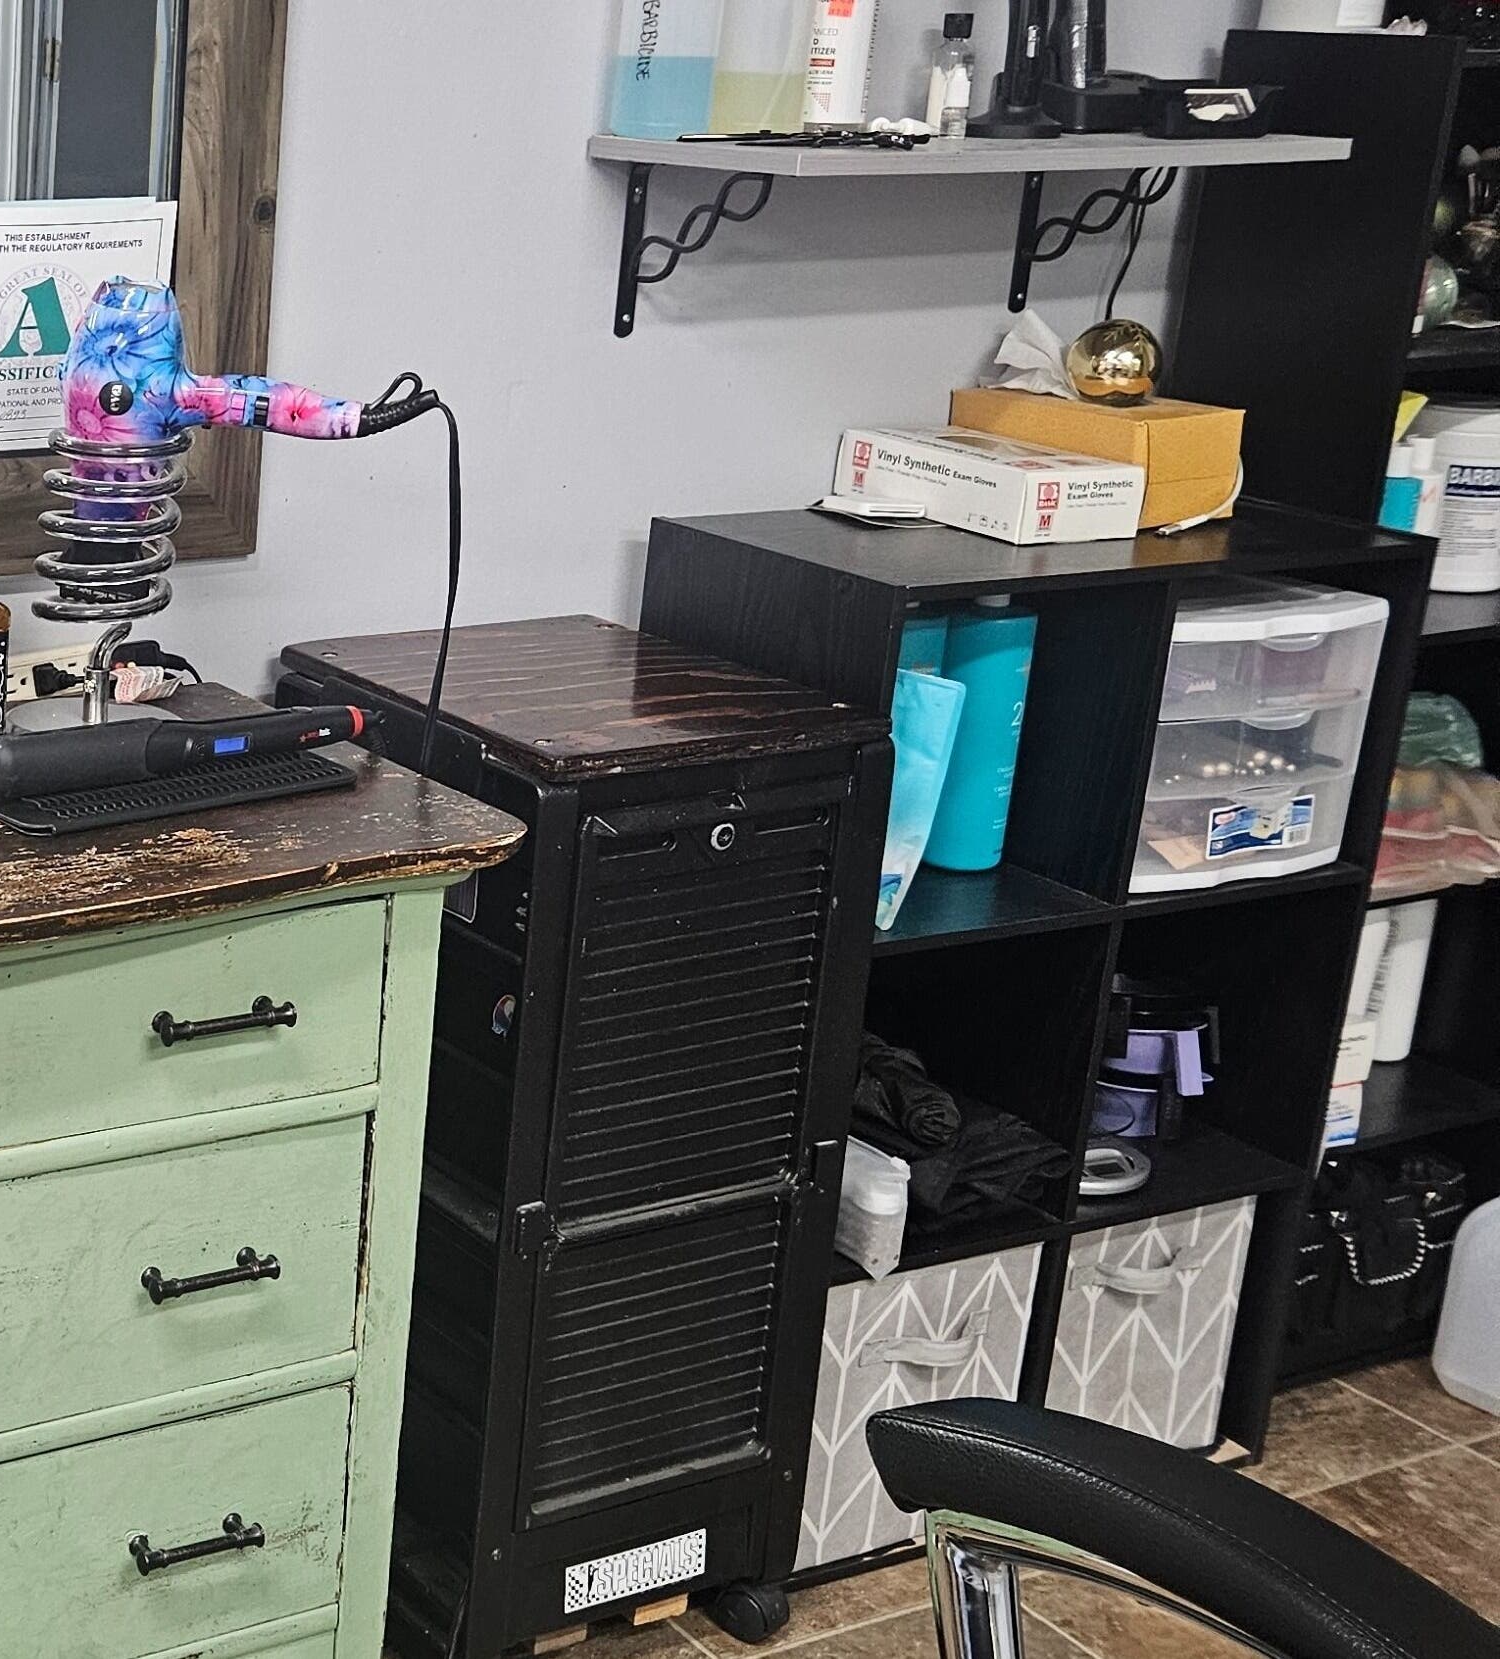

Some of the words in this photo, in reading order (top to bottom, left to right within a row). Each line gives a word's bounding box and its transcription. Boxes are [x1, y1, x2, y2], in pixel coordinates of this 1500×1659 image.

[811, 47, 836, 55] ITIZER
[5, 233, 23, 242] THIS
[25, 232, 91, 241] ESTABLISHMENT
[12, 244, 27, 252] THE
[29, 243, 82, 252] REGULATORY
[85, 239, 143, 250] REQUIREMENTS
[6, 388, 29, 396] STATE
[30, 387, 40, 395] OF
[41, 385, 61, 394] IDAH
[877, 448, 901, 466] Vinyl
[904, 456, 951, 477] Synthetic
[953, 470, 973, 482] Exam
[974, 476, 997, 488] Gloves
[1067, 482, 1090, 491] Vinyl
[1093, 481, 1134, 491] Synthetic
[596, 1536, 699, 1597] SPECIALS
